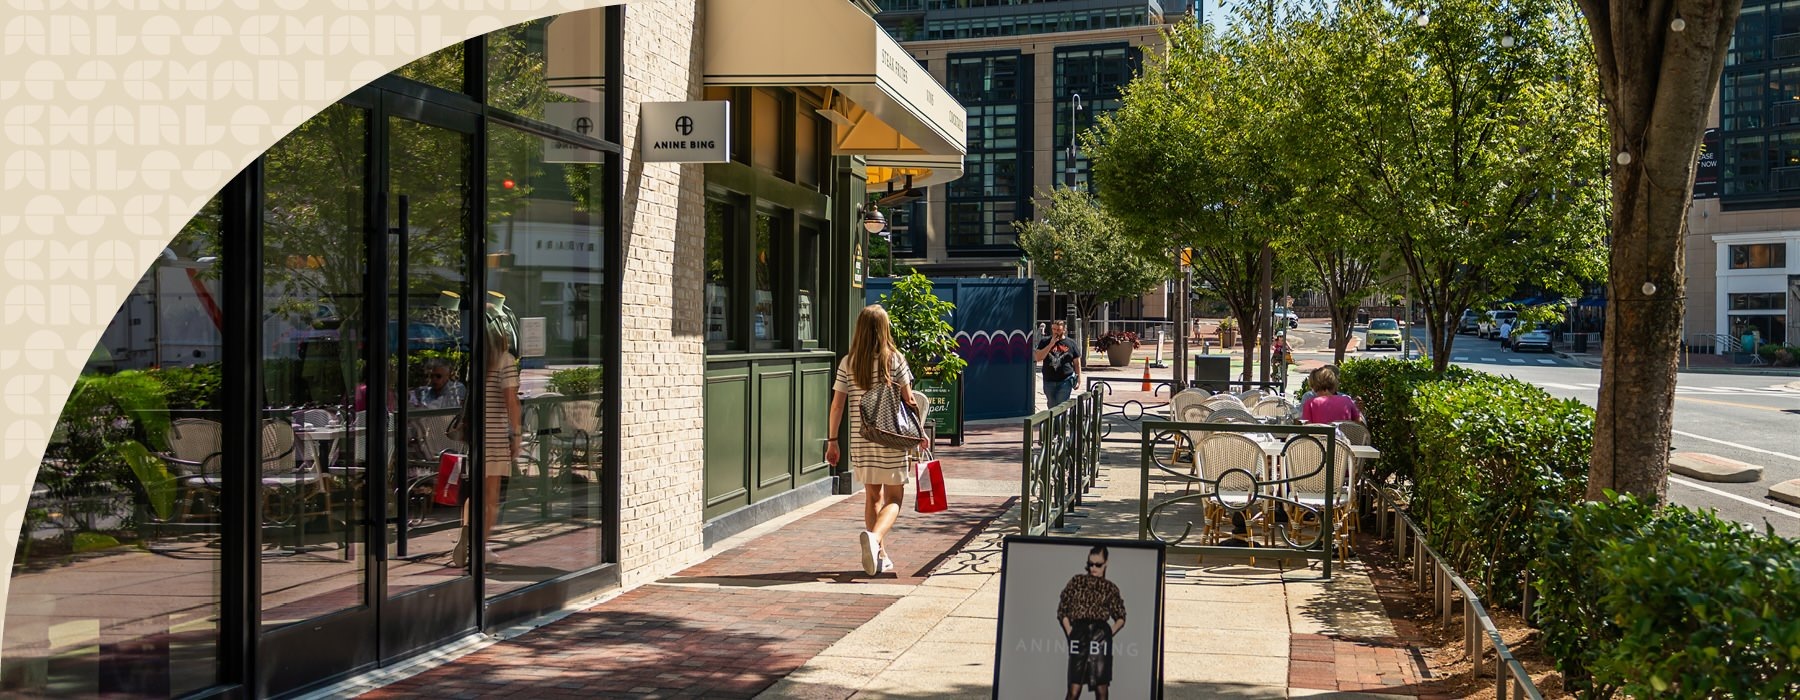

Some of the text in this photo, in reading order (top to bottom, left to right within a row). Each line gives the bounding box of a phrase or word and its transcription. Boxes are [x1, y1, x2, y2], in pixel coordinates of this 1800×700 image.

[881, 49, 908, 84] STEAK FRITES
[653, 140, 715, 150] ANINE BING
[928, 401, 949, 415] pen!
[1015, 639, 1139, 657] ANINE BING
